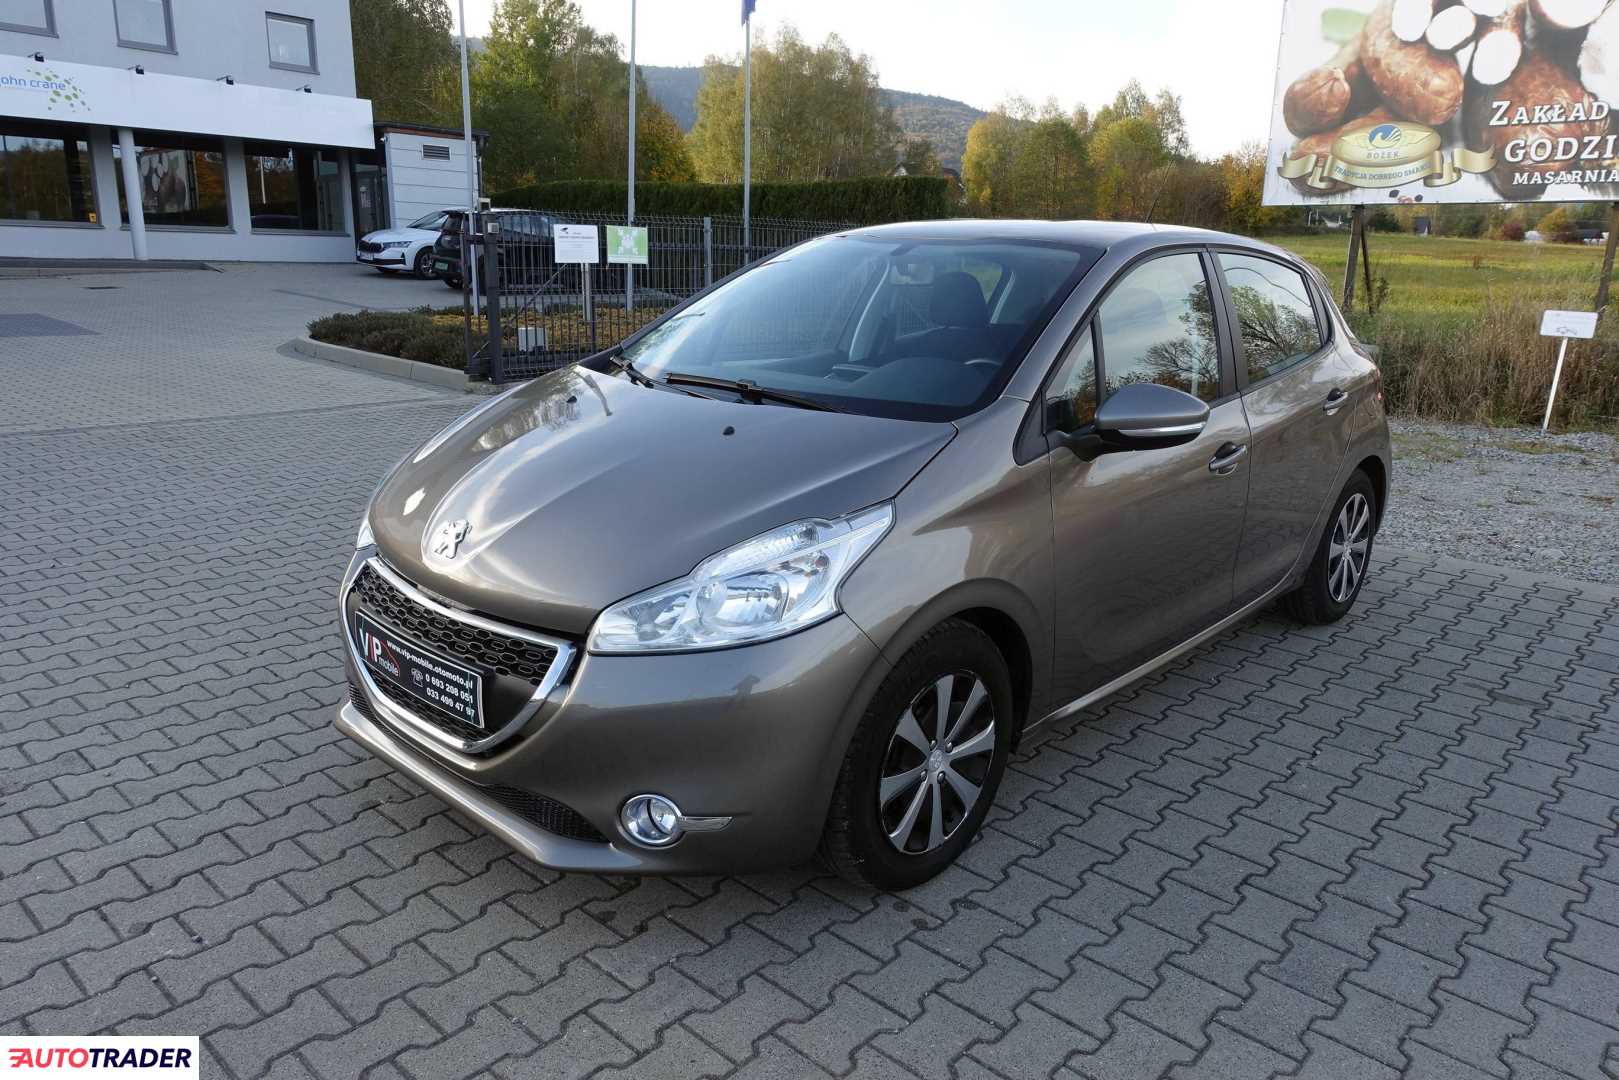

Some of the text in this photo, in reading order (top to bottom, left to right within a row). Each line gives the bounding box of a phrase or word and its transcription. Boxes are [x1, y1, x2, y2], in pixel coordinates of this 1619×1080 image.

[0, 75, 66, 91] ohn crane
[1489, 100, 1609, 126] ZAKŁAD
[1504, 135, 1619, 163] GODZI
[1512, 169, 1619, 185] MASARNIA
